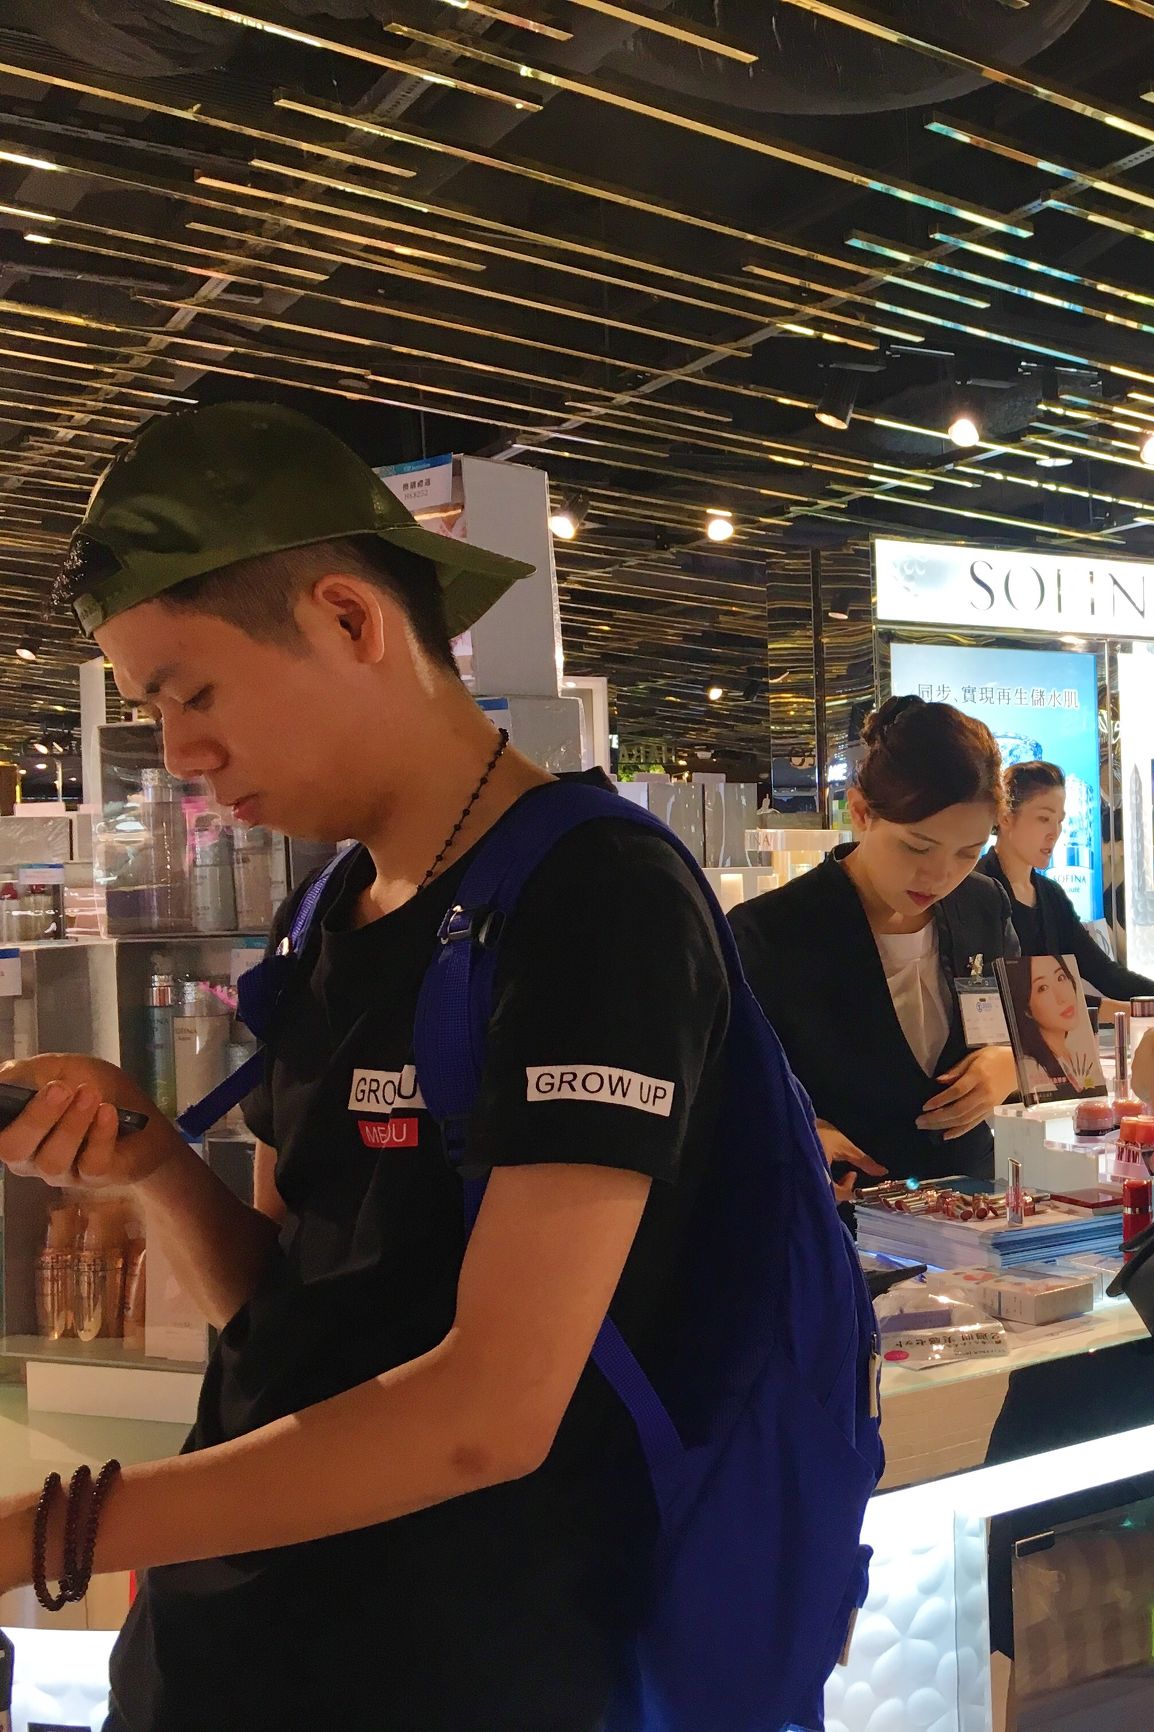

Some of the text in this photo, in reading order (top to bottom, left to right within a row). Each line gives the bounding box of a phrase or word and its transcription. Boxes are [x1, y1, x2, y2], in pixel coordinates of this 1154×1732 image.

[1052, 874, 1087, 884] SOFINA
[535, 1070, 668, 1107] GROW UP
